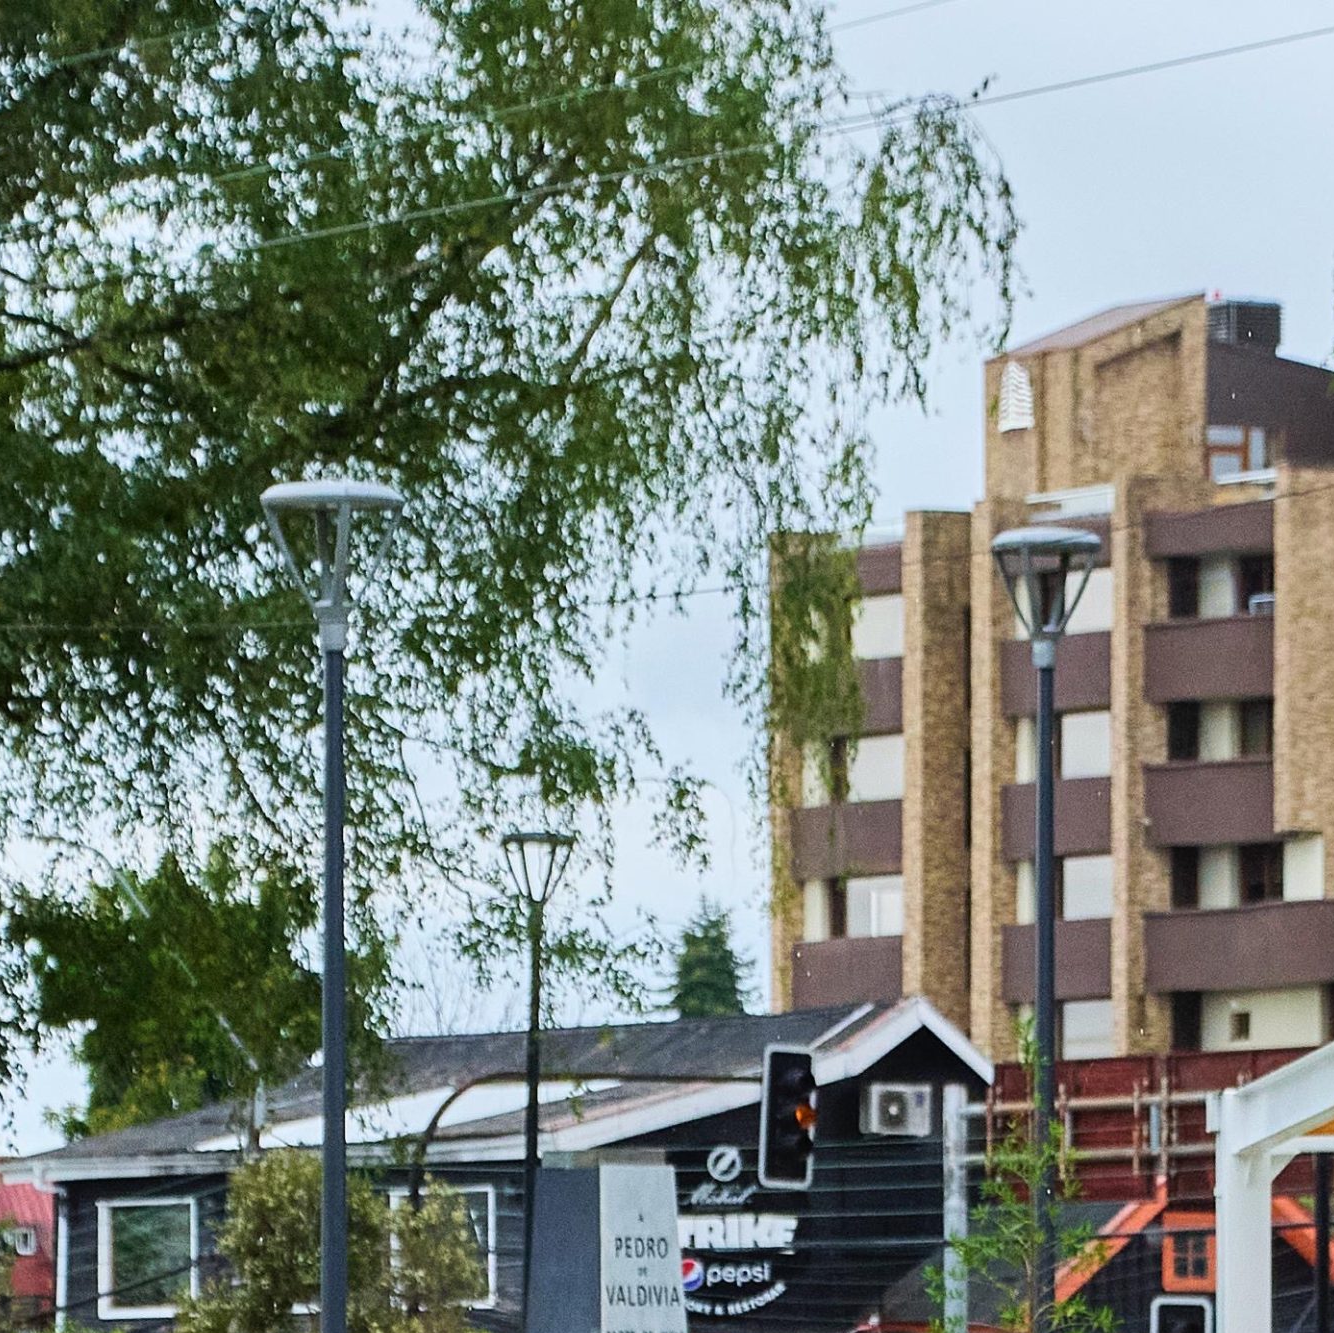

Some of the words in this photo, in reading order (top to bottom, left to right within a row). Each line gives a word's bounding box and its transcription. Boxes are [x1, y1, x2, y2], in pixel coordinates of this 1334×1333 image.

[676, 1213, 798, 1251] TRIKE
[614, 1237, 669, 1258] PEDRO
[706, 1262, 771, 1288] pepsi
[605, 1285, 681, 1307] VALDIVIA
